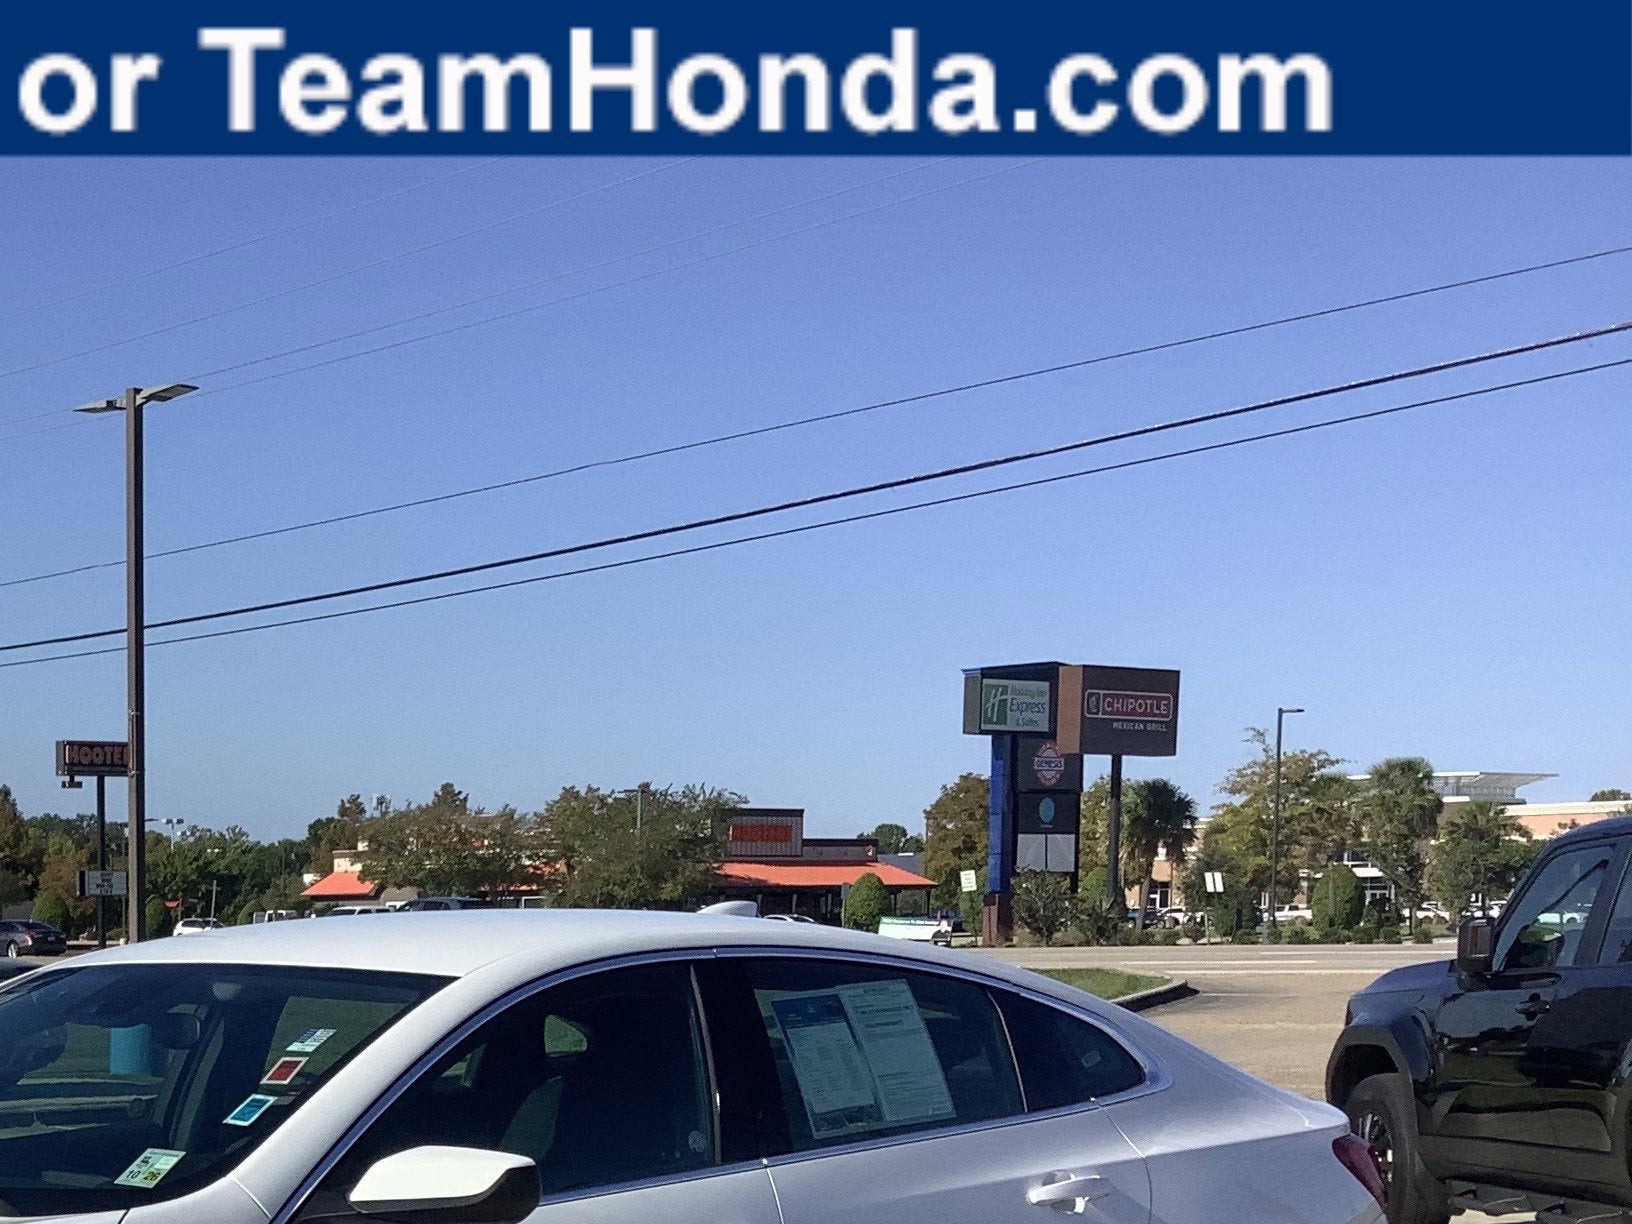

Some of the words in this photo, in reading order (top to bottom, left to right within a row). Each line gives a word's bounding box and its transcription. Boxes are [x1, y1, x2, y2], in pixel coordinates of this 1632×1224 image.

[1009, 699, 1047, 716] Express
[1104, 697, 1168, 715] CHIPOTLE
[1112, 721, 1144, 731] MEXICAN
[1146, 722, 1167, 732] GRILL
[125, 1169, 142, 1180] 10
[143, 1170, 162, 1181] 26
